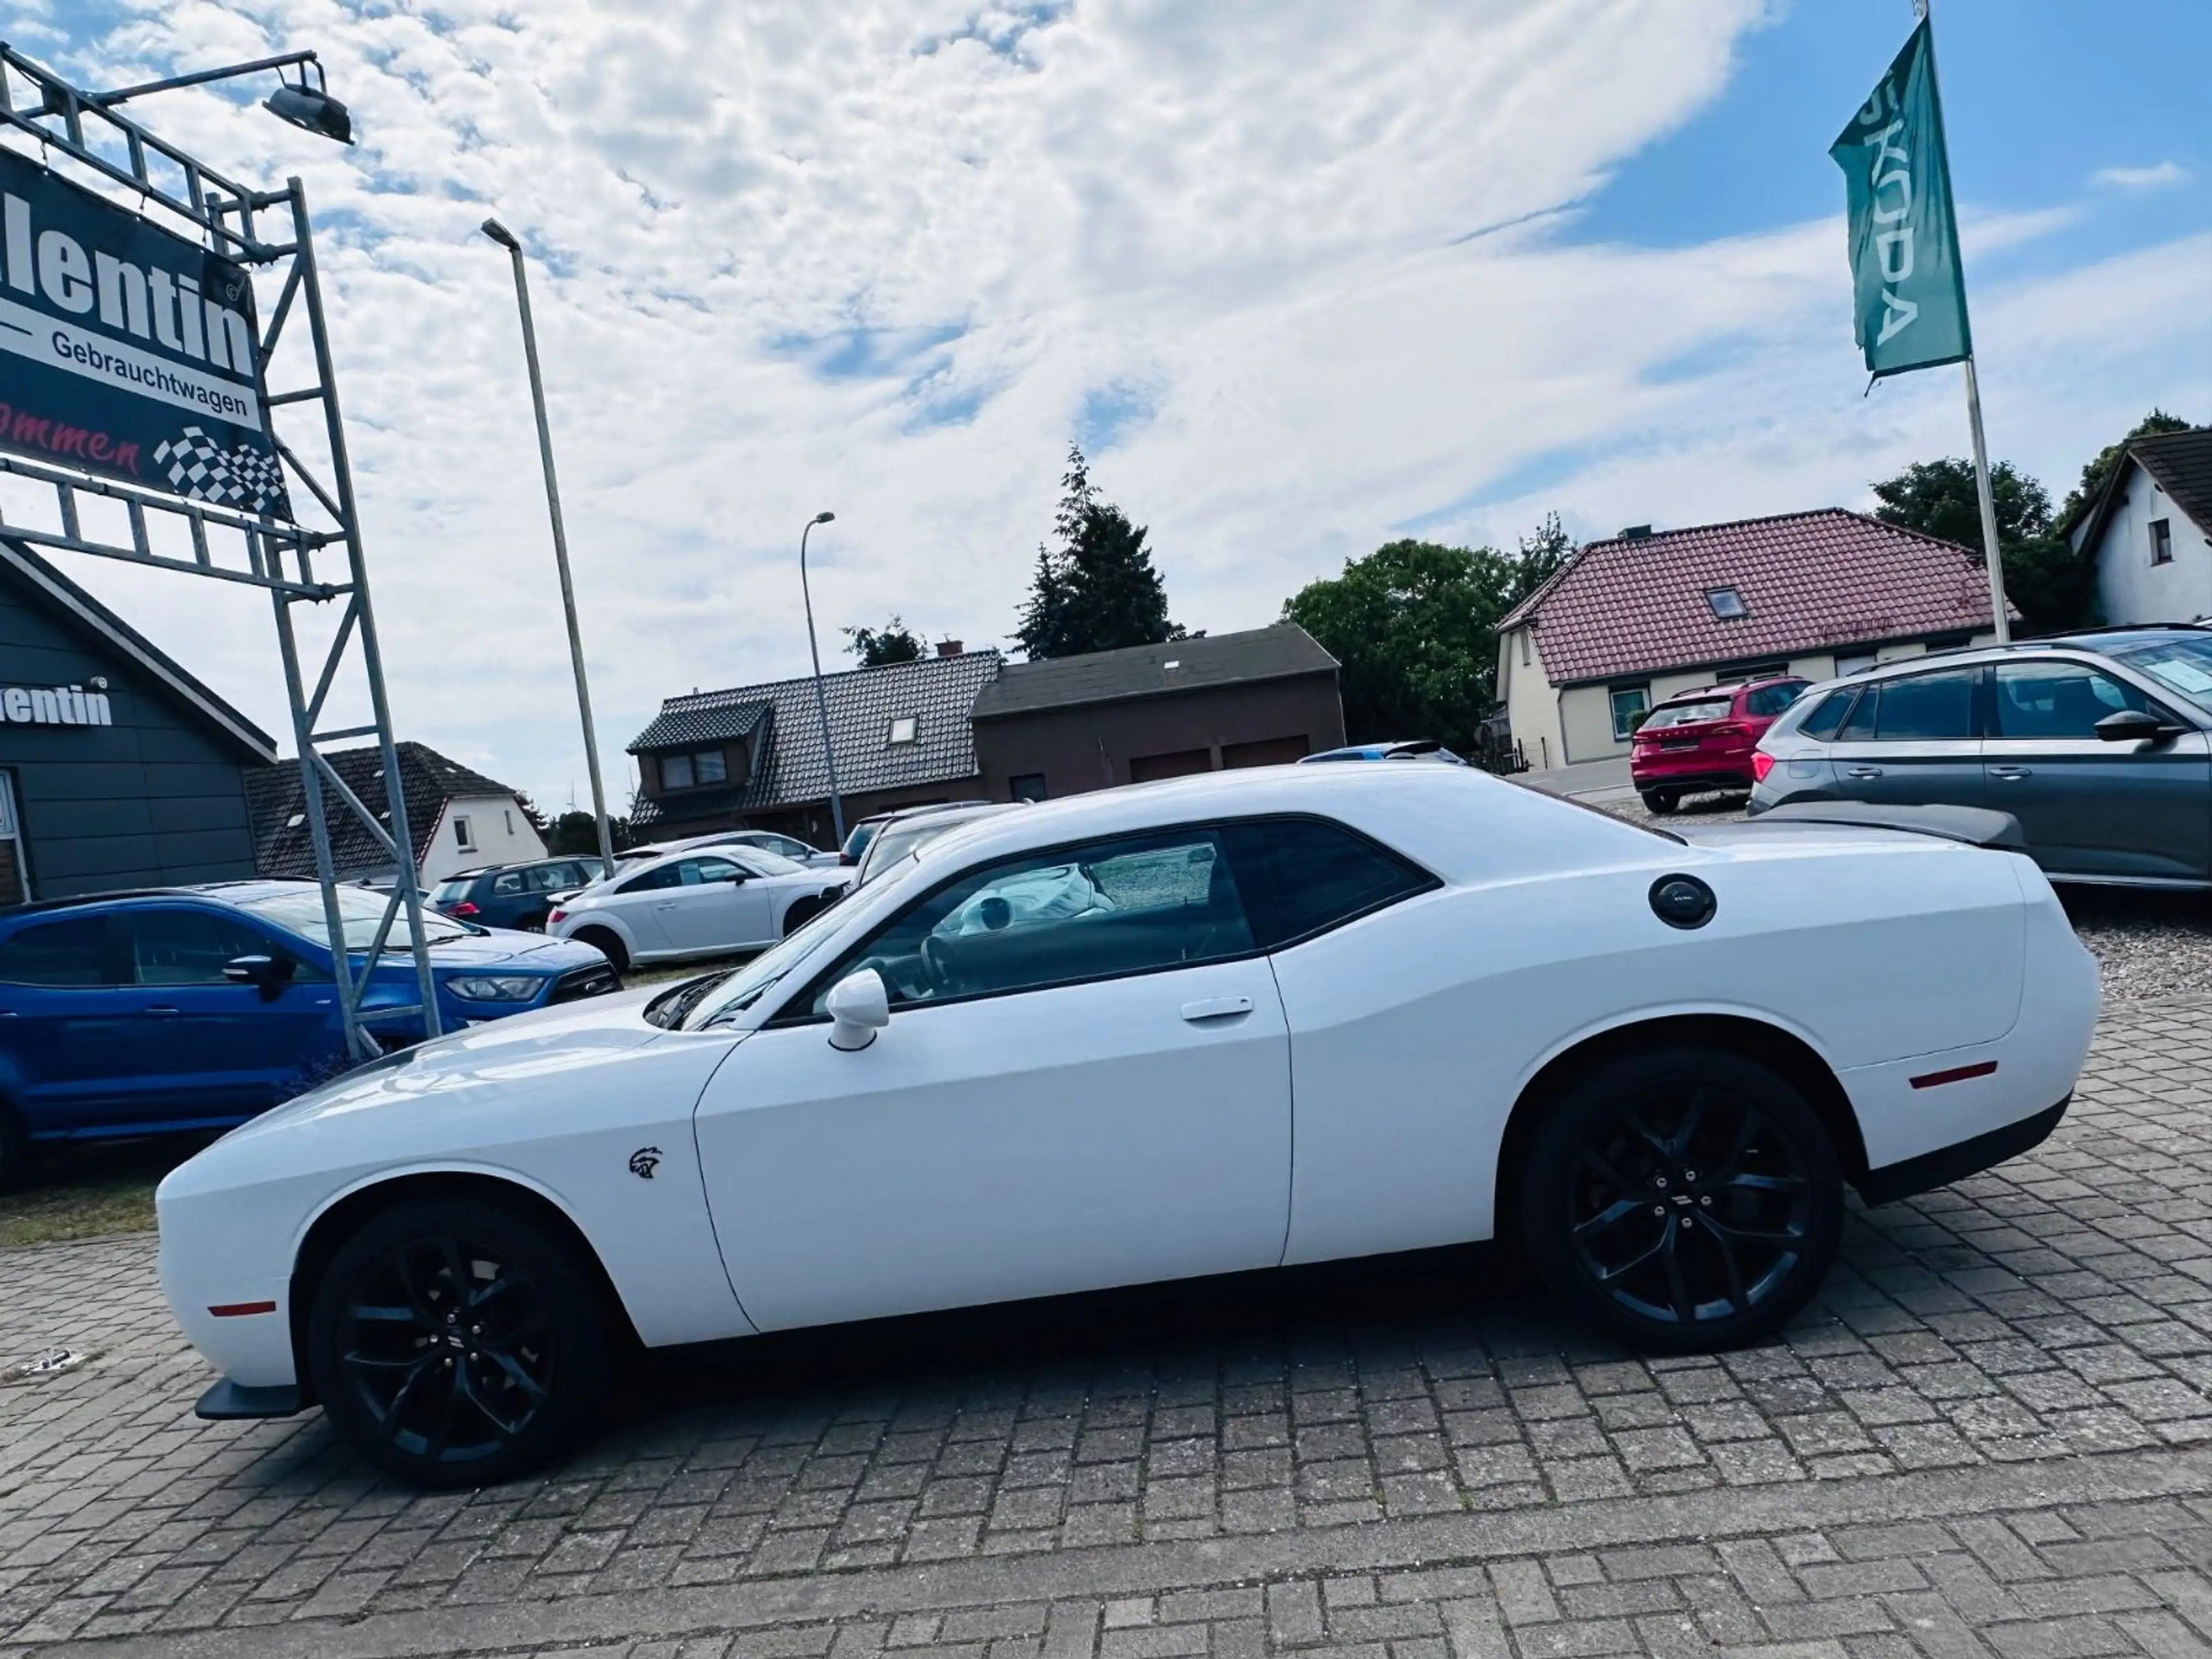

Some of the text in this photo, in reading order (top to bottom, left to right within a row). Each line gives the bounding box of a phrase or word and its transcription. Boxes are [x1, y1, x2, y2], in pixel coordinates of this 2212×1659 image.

[0, 191, 253, 377] lentin
[51, 331, 248, 417] Gebrauchtwagen
[0, 684, 112, 726] entin
